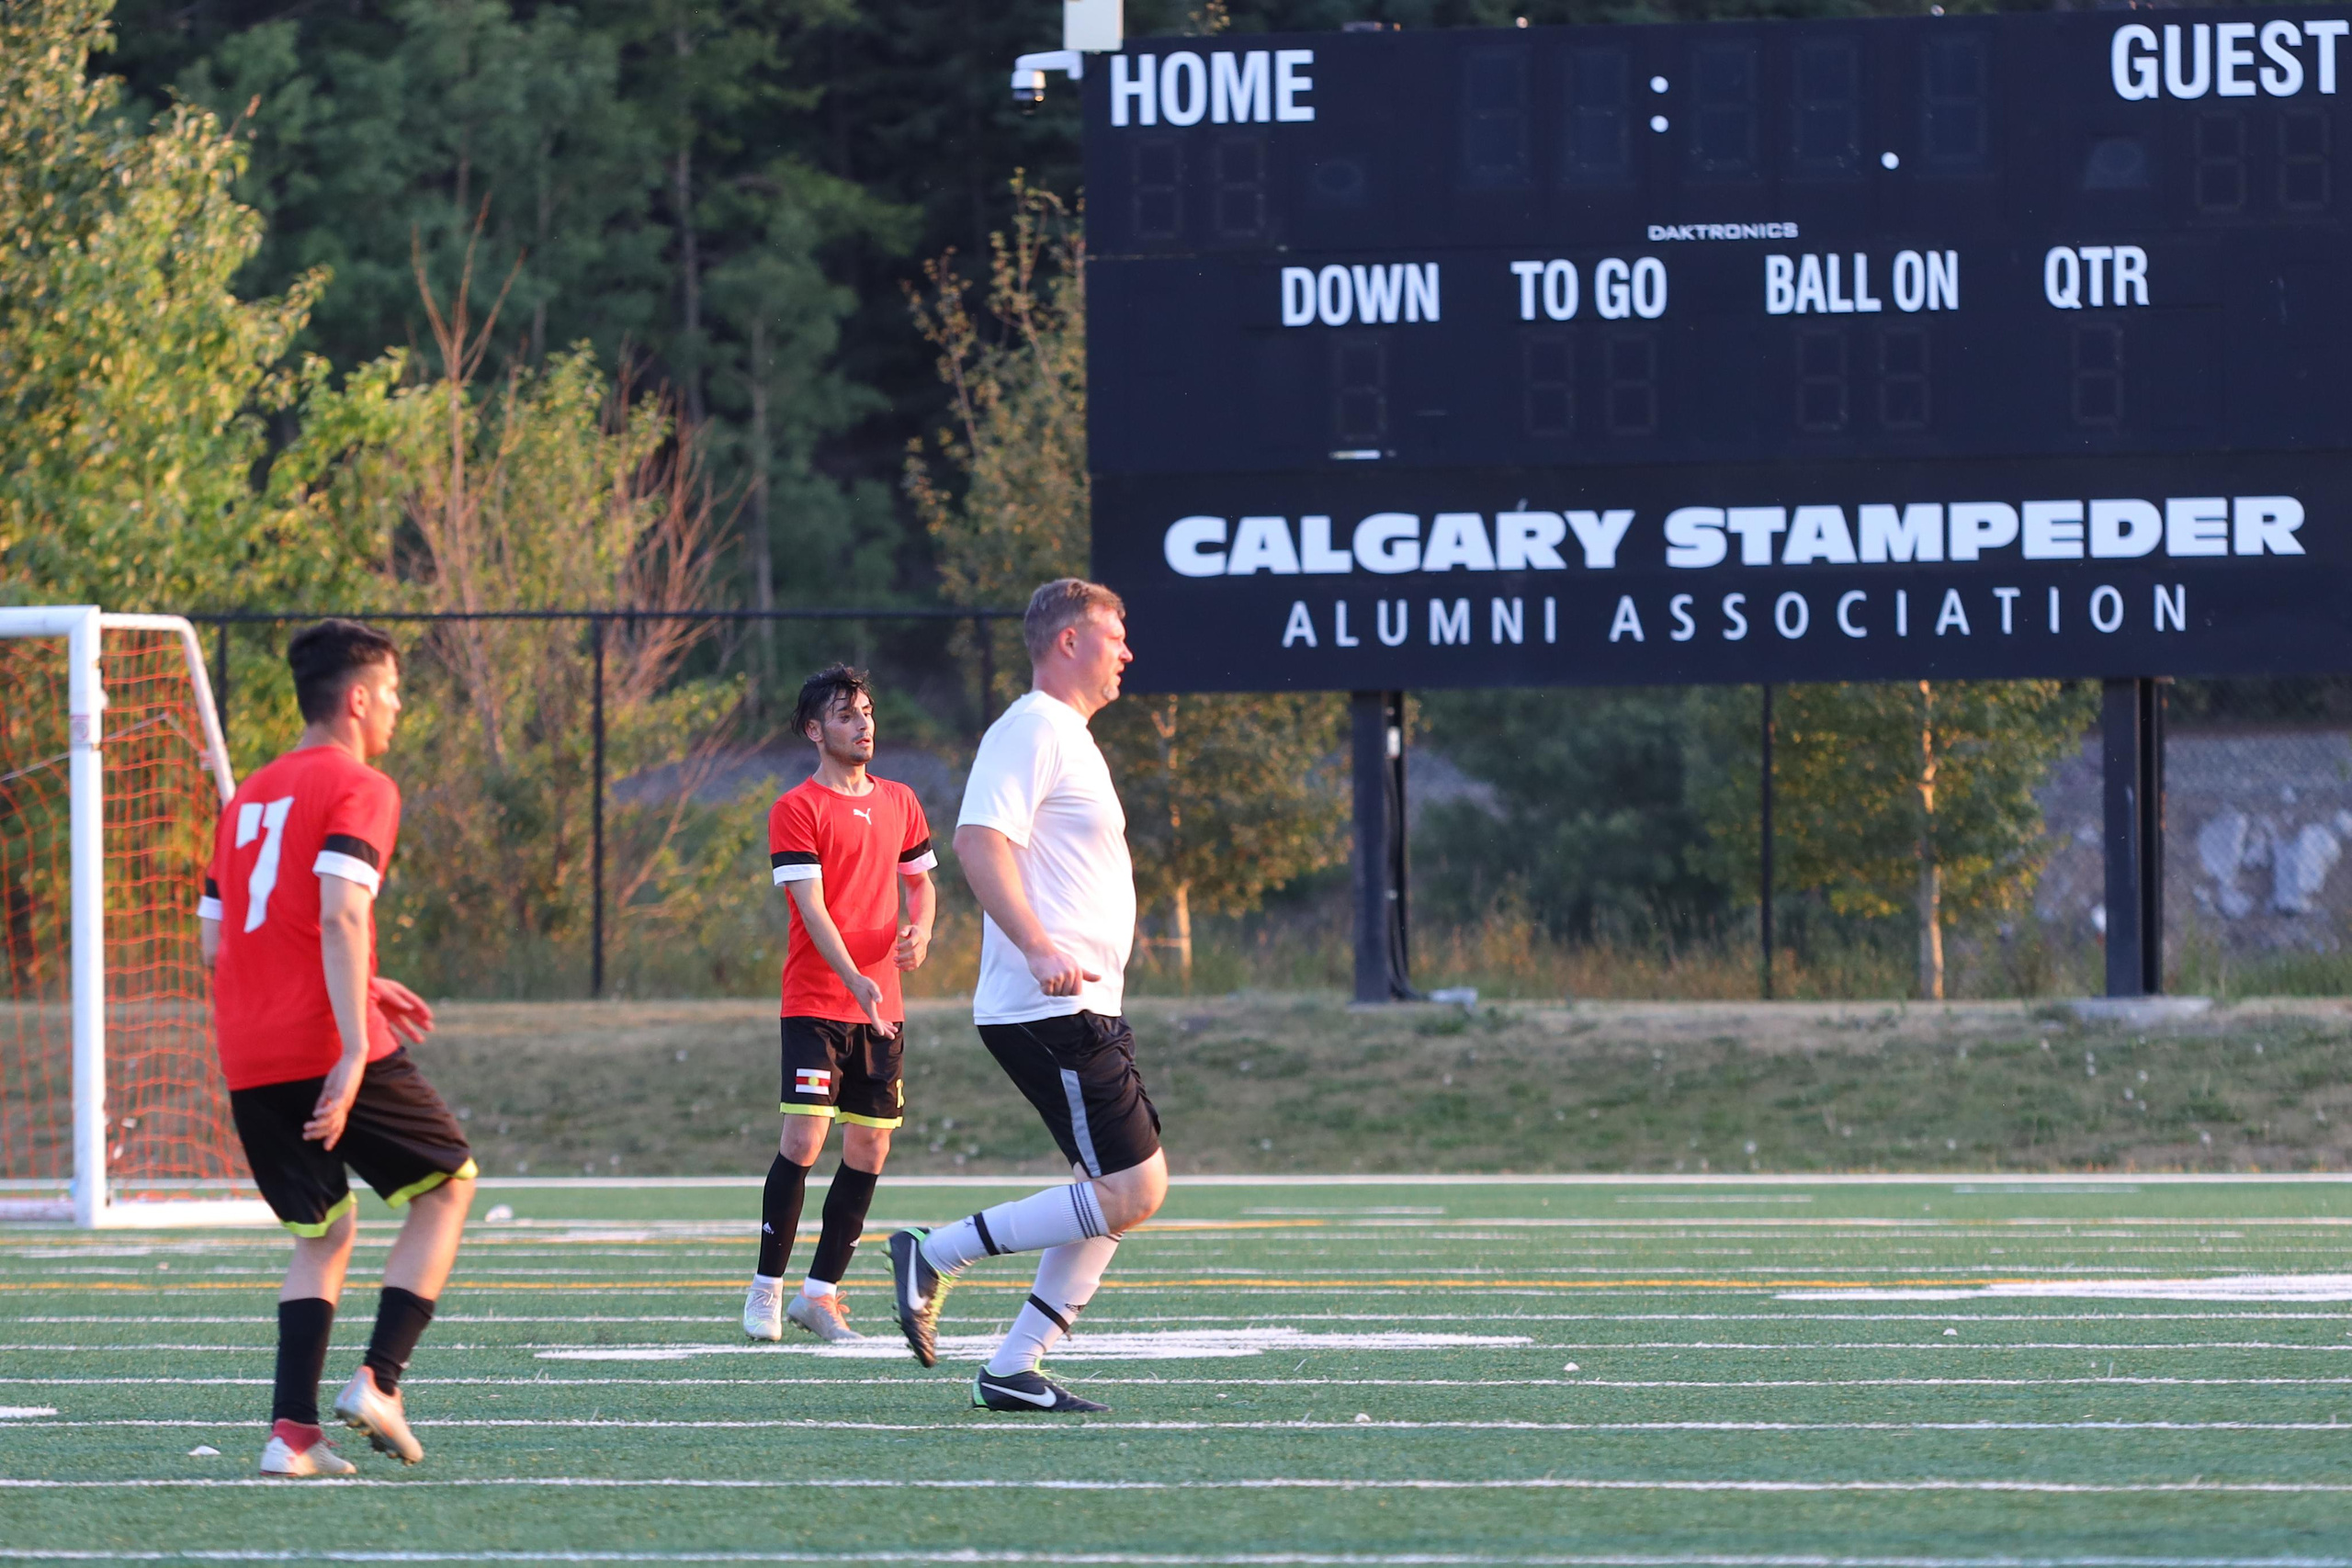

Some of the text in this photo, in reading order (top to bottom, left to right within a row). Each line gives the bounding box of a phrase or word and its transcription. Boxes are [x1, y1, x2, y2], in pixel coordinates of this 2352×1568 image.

[1110, 49, 1316, 128] HOME
[2110, 19, 2350, 101] GUEST
[1647, 221, 1799, 242] DAKTRONICS
[1281, 262, 1441, 327] DOWN
[1510, 256, 1668, 321] TO GO
[1765, 249, 1959, 315] BALL ON
[2044, 245, 2150, 310] QTR
[1163, 495, 2306, 577] CALGARY STAMPEDER
[1282, 583, 2187, 649] ALUMNI ASSOCIATION
[235, 795, 295, 934] 7
